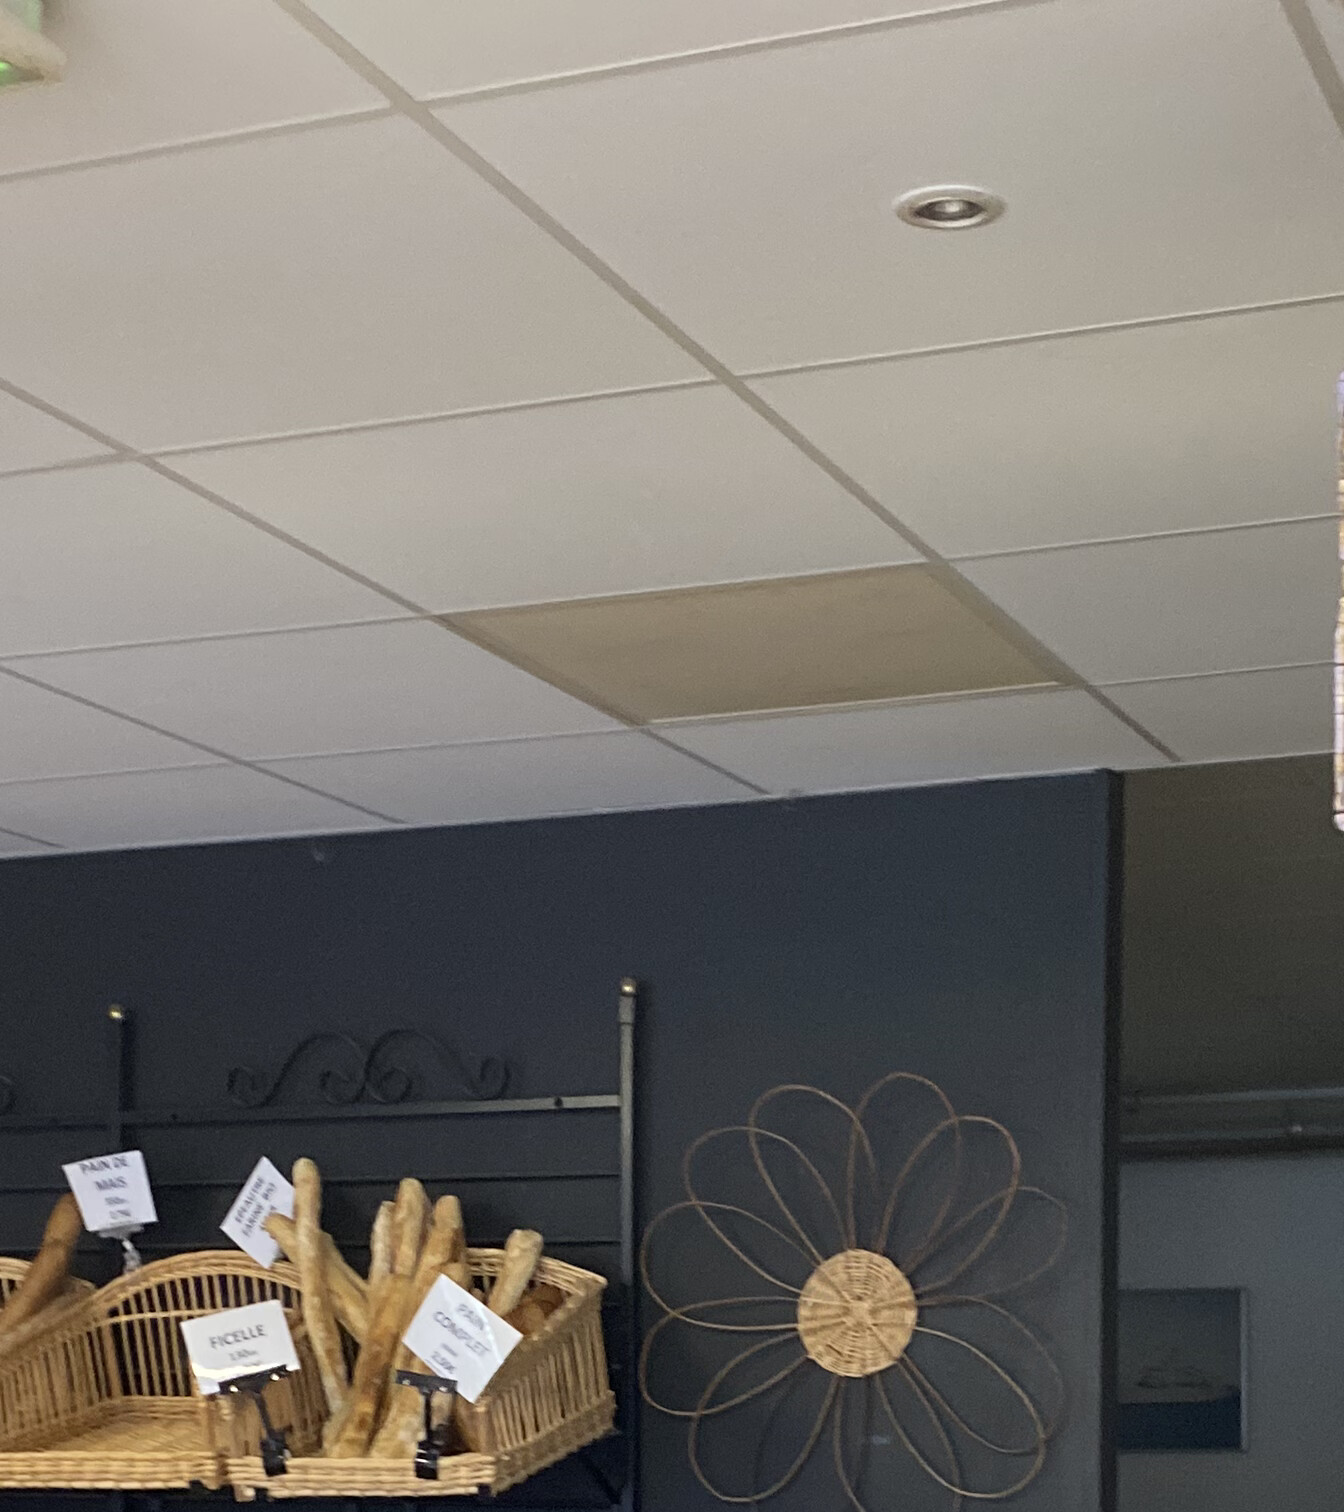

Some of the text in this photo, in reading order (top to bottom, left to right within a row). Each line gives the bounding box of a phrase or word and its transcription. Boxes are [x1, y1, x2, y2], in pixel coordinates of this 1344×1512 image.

[79, 1158, 112, 1176] PAIN
[456, 1303, 485, 1332] PAIN
[209, 1324, 268, 1351] FICELLE
[432, 1310, 492, 1357] COMPLET
